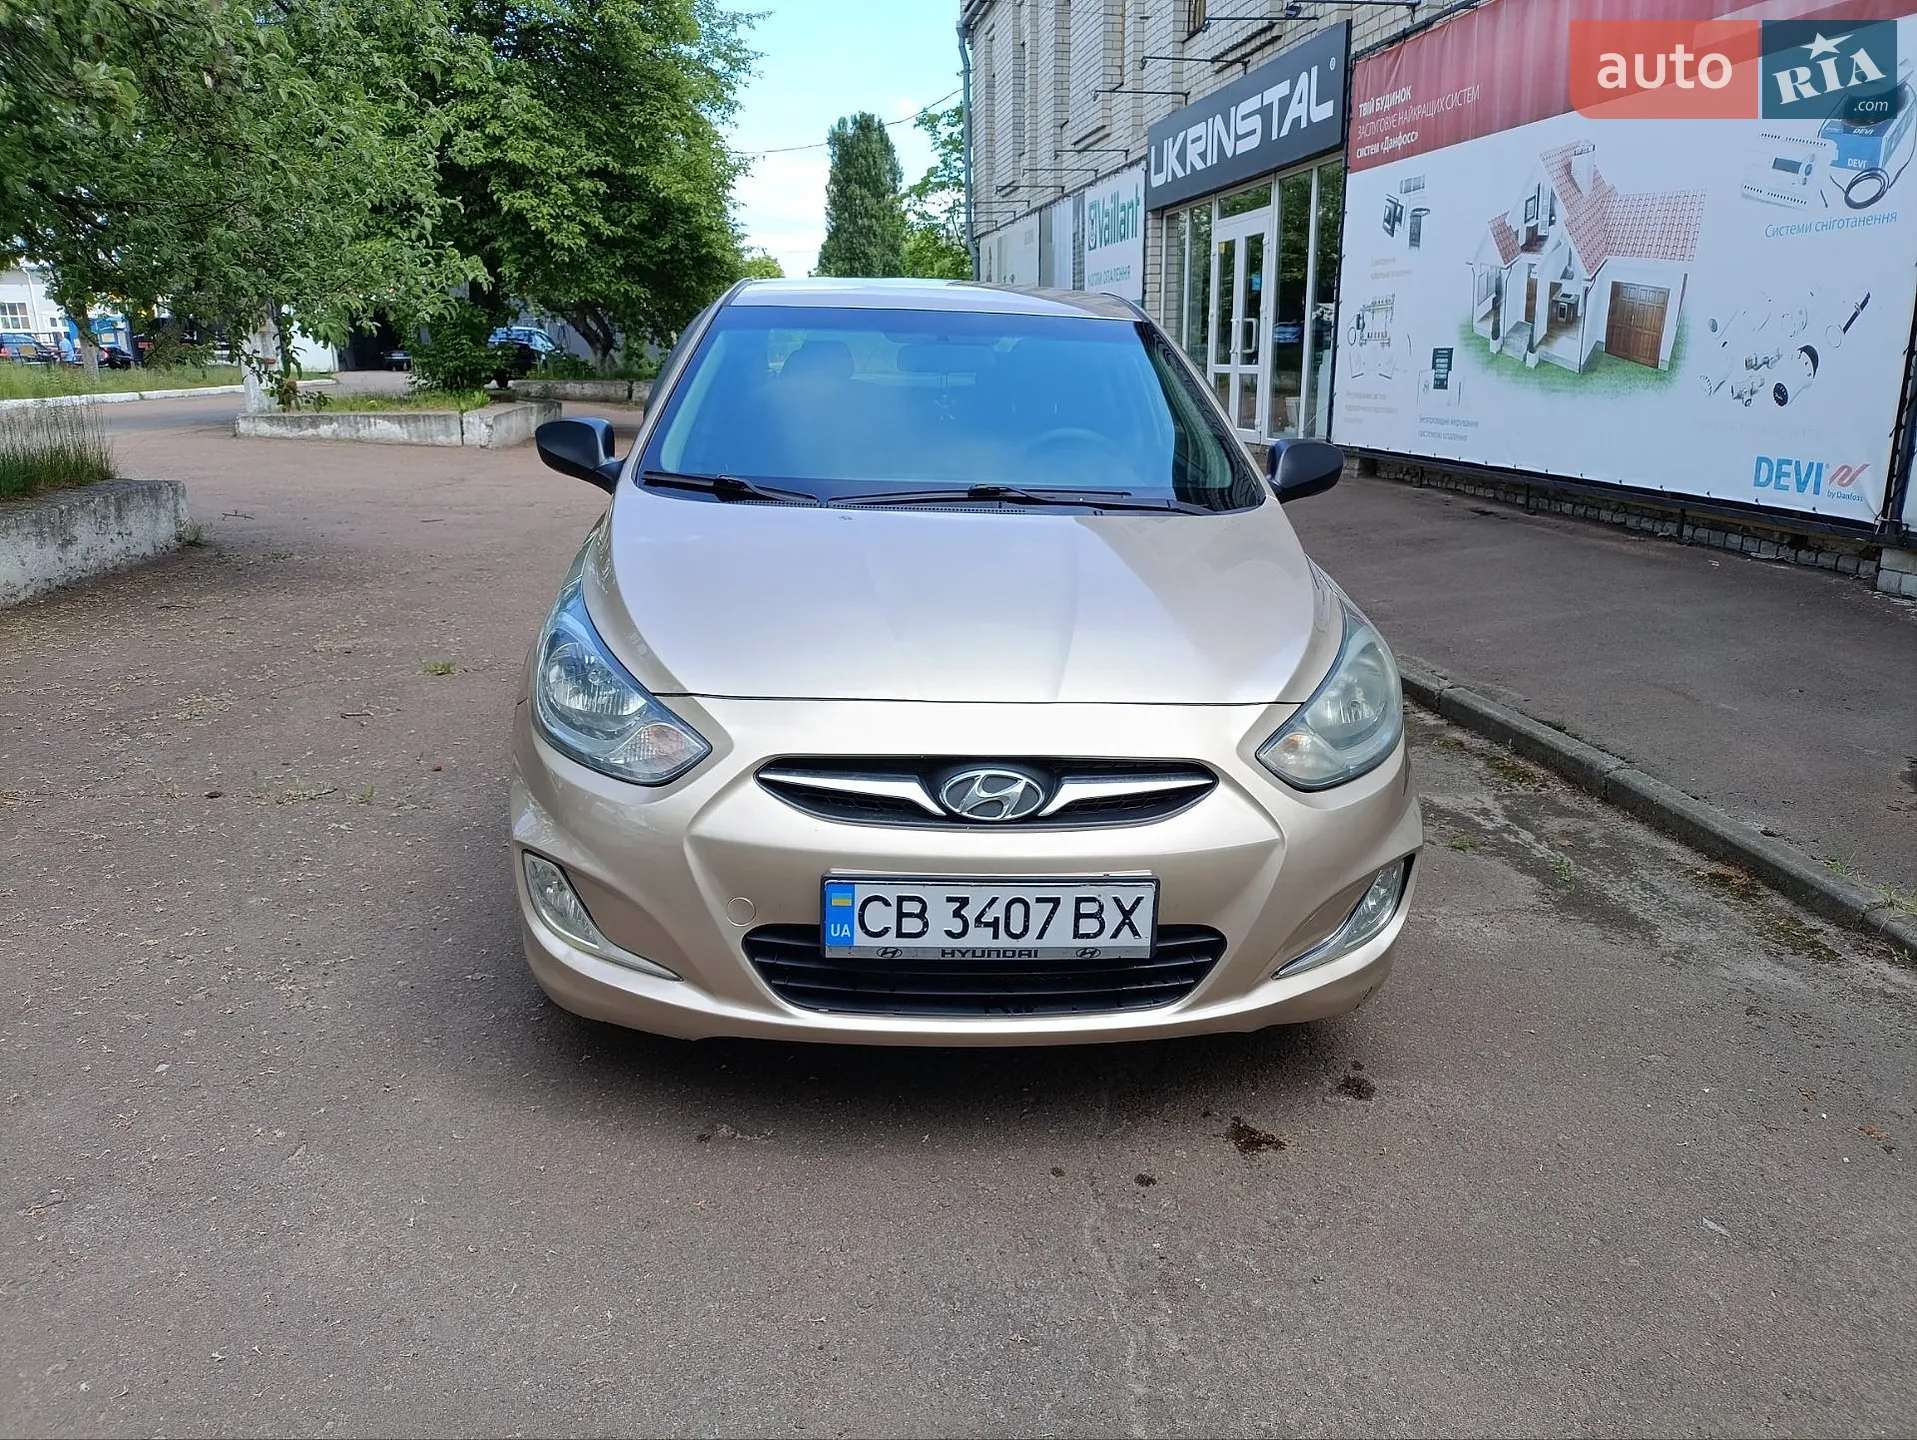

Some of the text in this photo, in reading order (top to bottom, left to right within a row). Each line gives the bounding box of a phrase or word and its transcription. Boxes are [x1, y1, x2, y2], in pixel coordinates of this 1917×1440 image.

[1358, 85, 1412, 118] ТВІЙ БУДИНОК
[1358, 83, 1480, 139] ЗАСЛУГОВУЄ НАЙКРАЩИХ СИСТЕМ
[1151, 65, 1334, 188] UKRINSTAL
[1853, 127, 1875, 135] DEVI
[1356, 143, 1380, 159] систем
[1847, 158, 1867, 169] DEVI
[1098, 182, 1140, 248] Vaillant
[1764, 211, 1898, 238] Системи сніготанення
[1753, 456, 1824, 495] DEVI
[1827, 489, 1864, 502] by Danfoss
[830, 923, 851, 937] UA
[857, 894, 1145, 941] CB 3407 BX
[940, 949, 1039, 959] HYUNDAI
